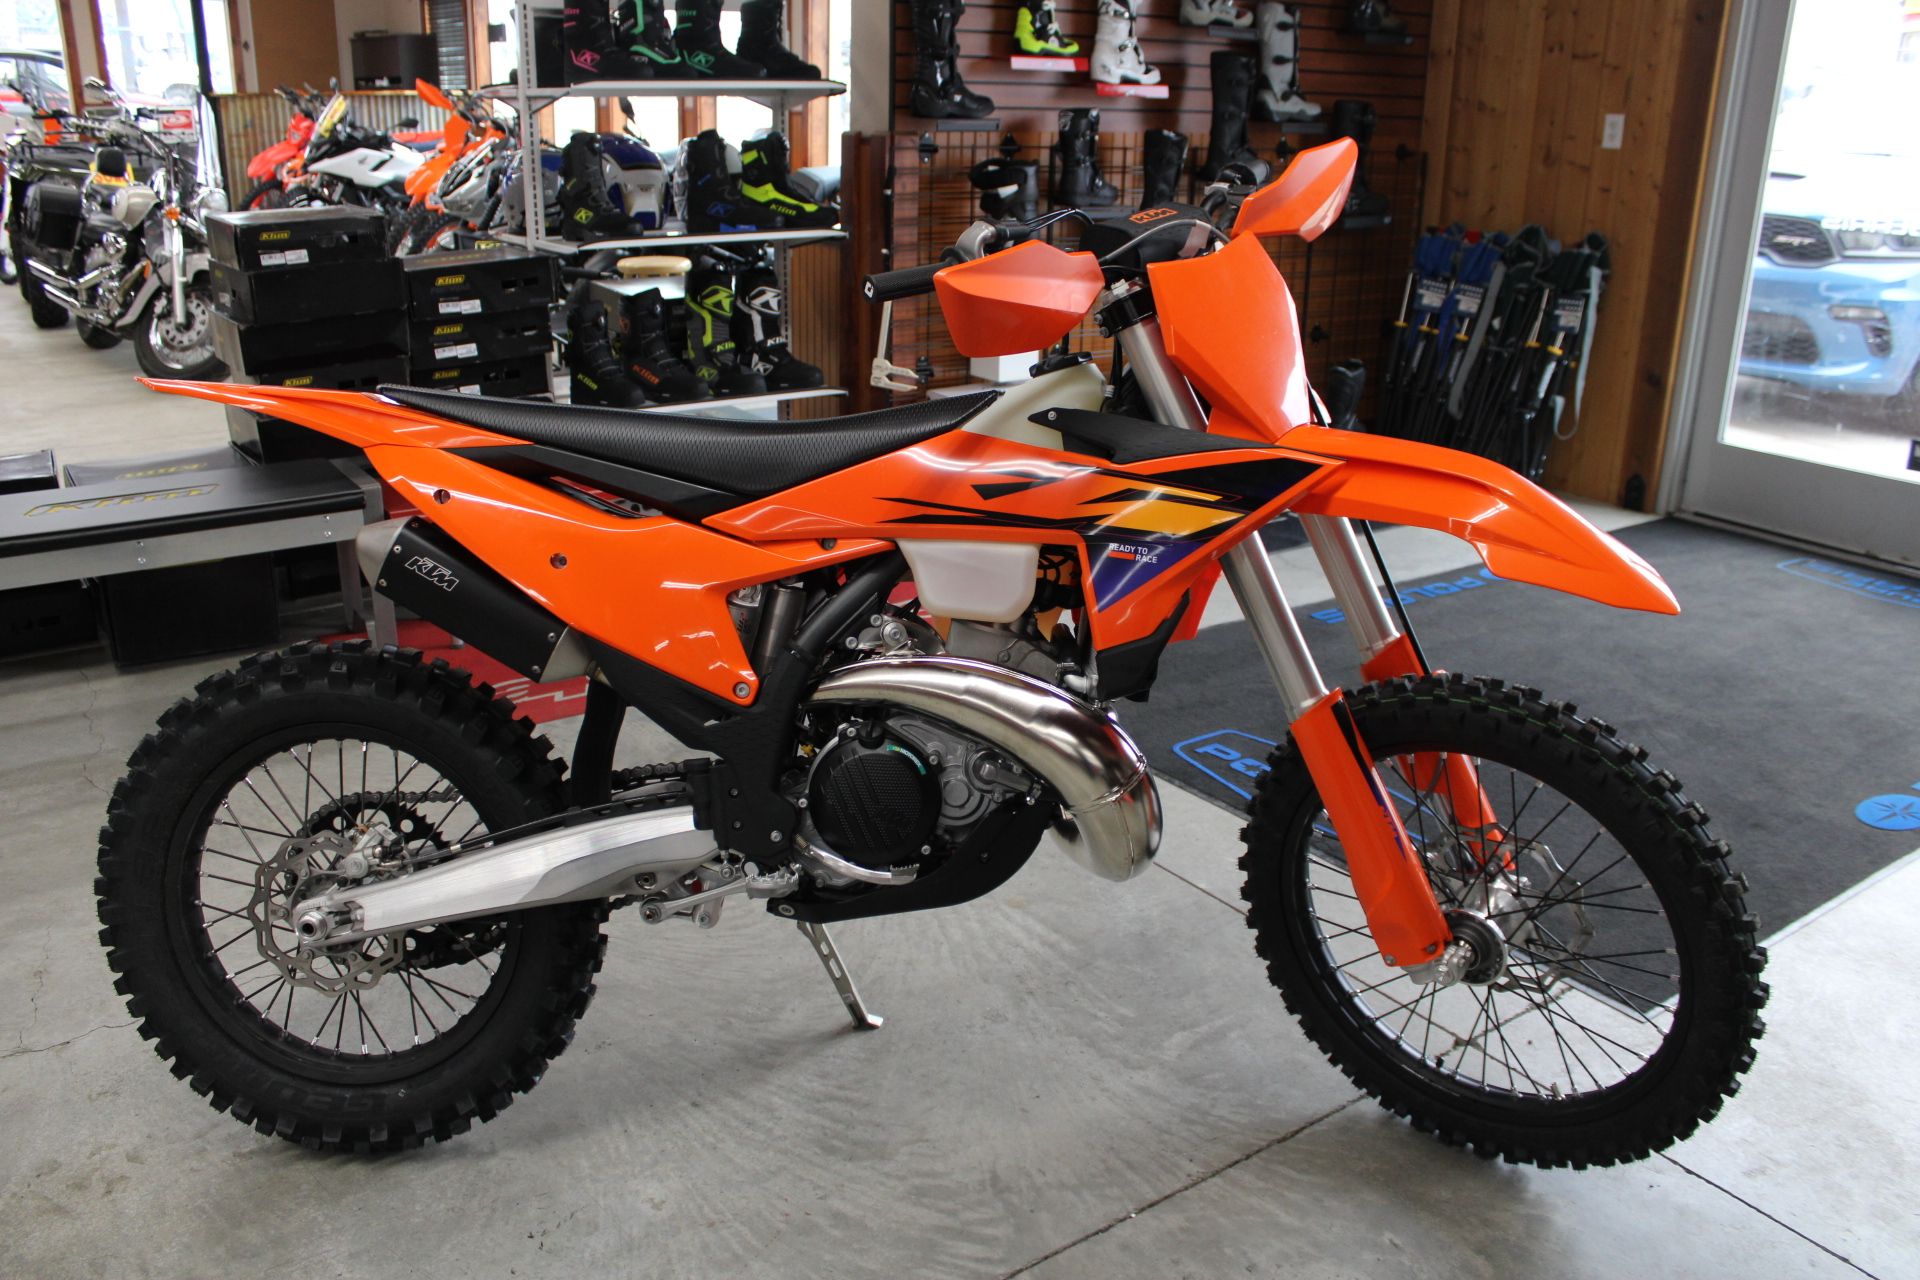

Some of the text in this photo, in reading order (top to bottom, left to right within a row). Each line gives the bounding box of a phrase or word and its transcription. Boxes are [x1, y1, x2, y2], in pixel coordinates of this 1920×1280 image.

[1108, 543, 1148, 555] READY TO
[1135, 554, 1158, 564] RACE
[404, 555, 460, 592] KTM
